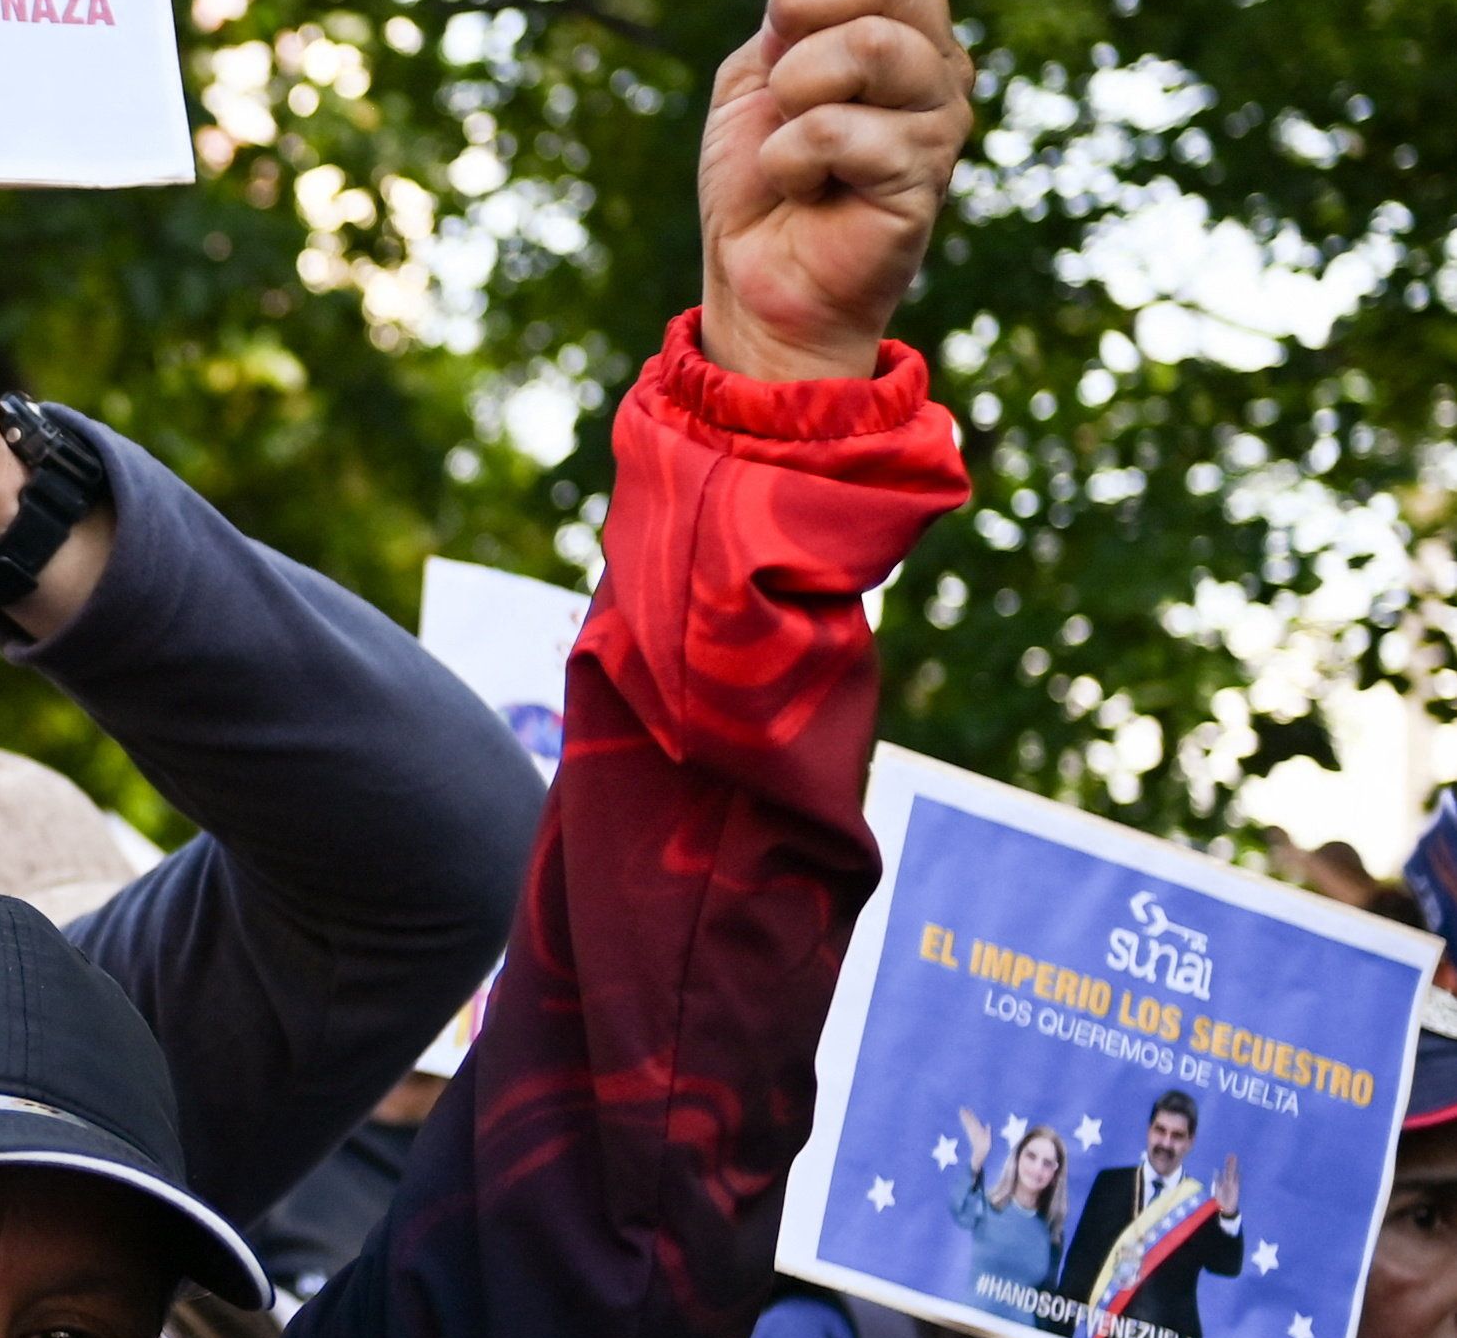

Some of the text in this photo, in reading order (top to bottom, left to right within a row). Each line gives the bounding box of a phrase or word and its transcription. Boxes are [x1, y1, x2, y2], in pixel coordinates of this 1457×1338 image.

[921, 923, 1374, 1107] EL IMPERIO LOS SECUESTRO
[984, 989, 1299, 1118] LOS QUEREMOS DE VUELTA
